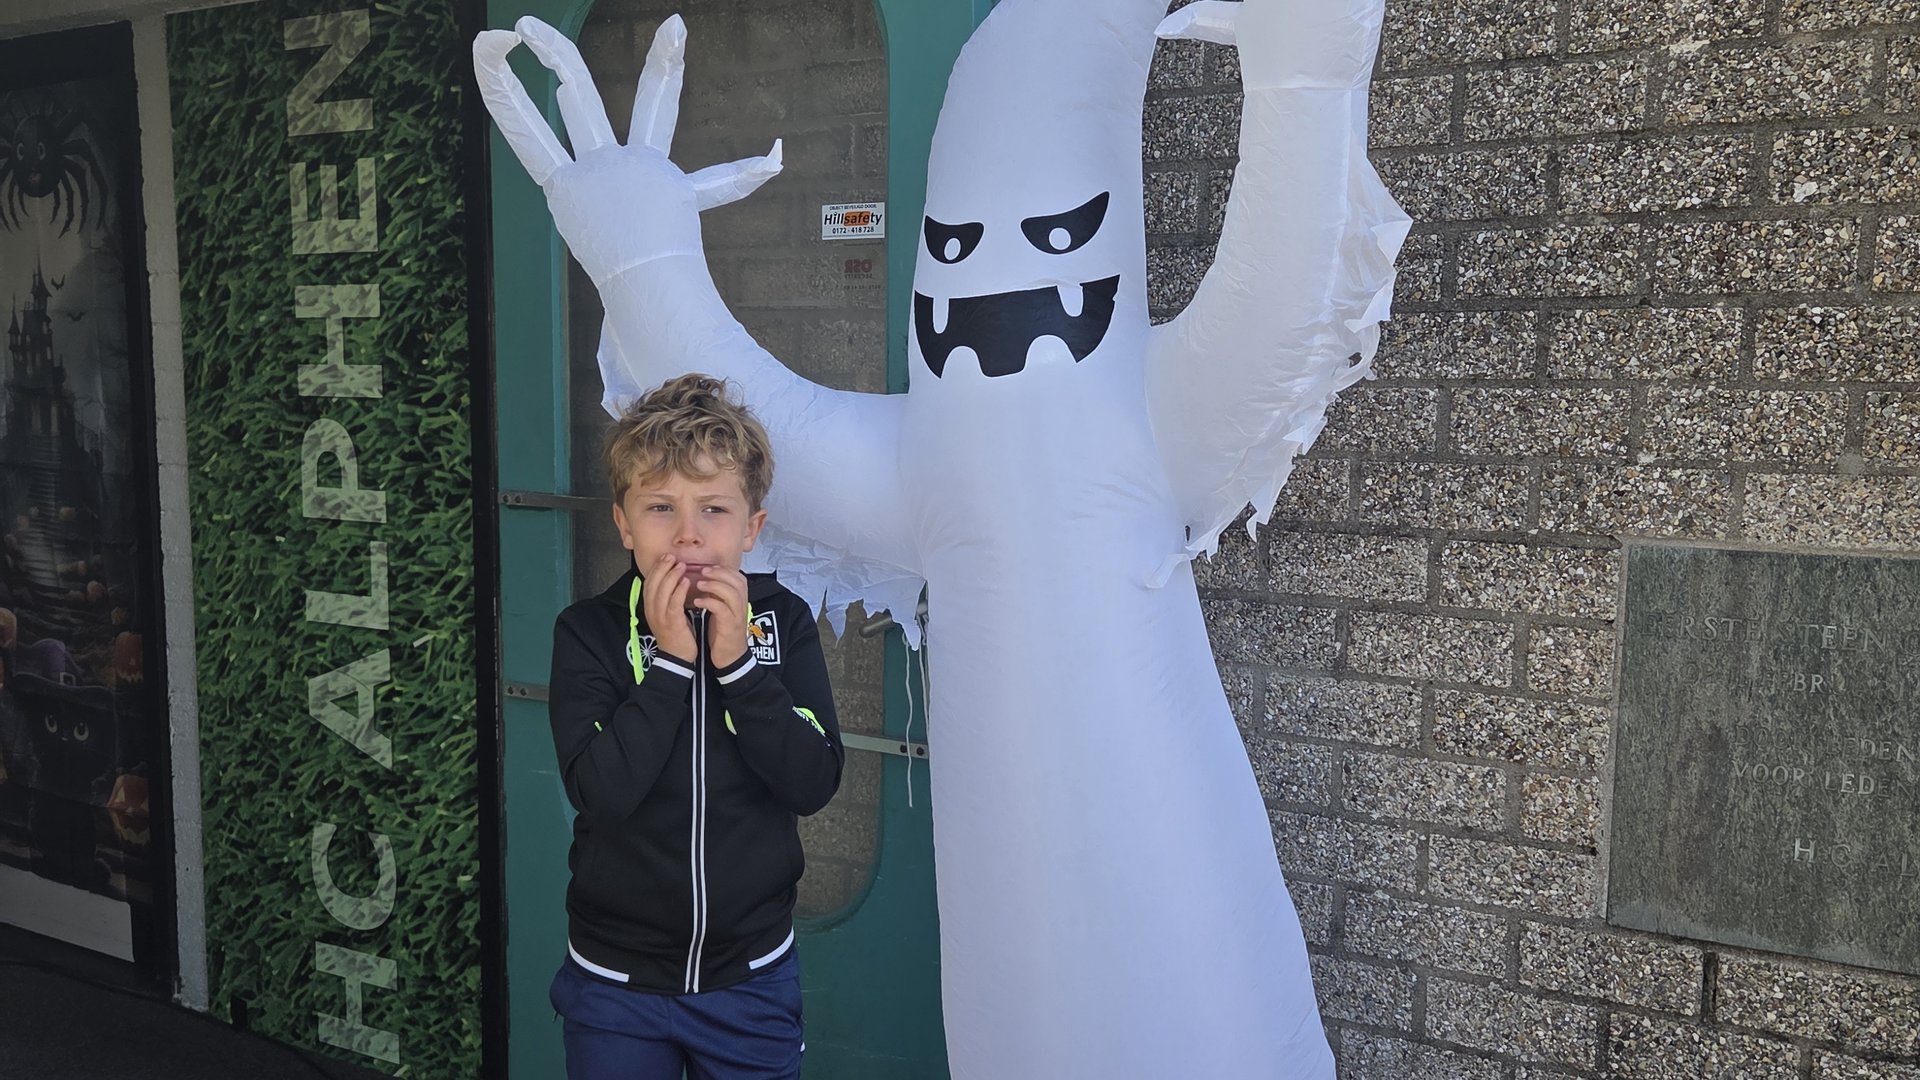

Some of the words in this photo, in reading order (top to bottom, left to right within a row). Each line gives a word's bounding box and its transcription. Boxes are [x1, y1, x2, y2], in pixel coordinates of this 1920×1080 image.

[824, 211, 882, 226] Hillsafety
[283, 8, 393, 770] ALPHEN
[750, 646, 775, 660] PHEN
[1731, 760, 1809, 788] VOOR
[1825, 771, 1914, 800] LEDEN
[312, 821, 400, 1065] HC
